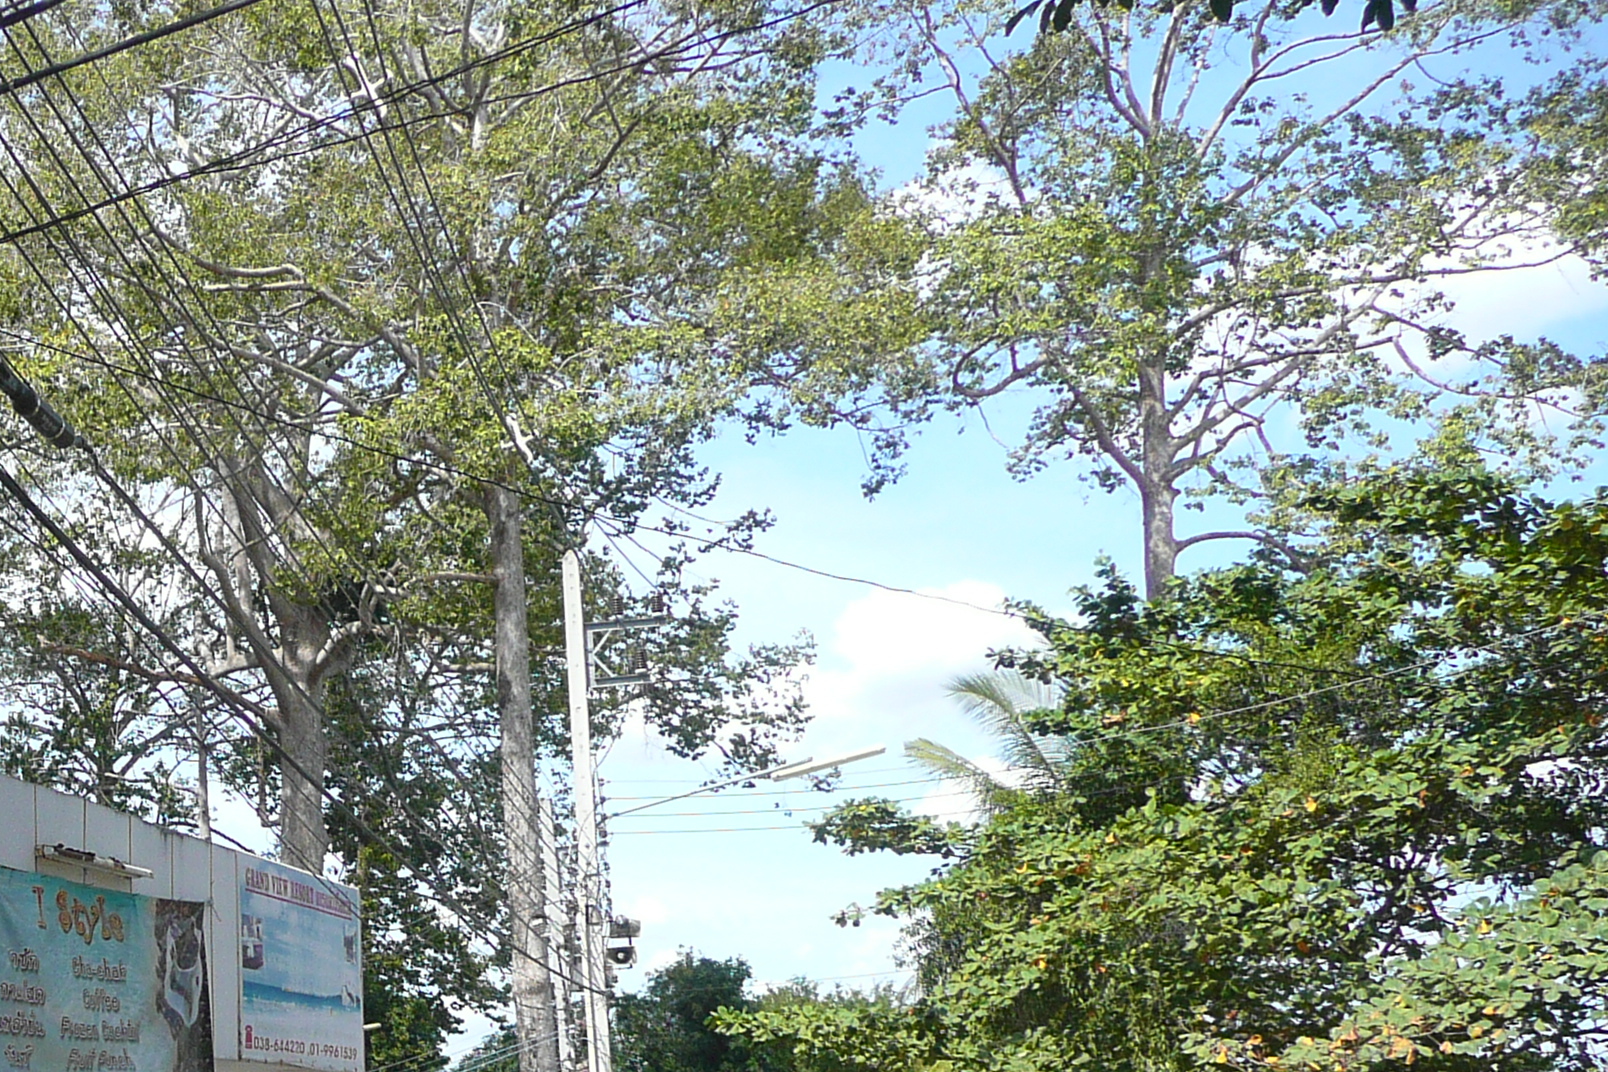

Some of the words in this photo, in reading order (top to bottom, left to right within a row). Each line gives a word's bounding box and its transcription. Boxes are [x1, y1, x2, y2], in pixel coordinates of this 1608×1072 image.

[32, 886, 47, 929] I
[56, 890, 124, 945] Style
[82, 987, 120, 1013] Coffee
[253, 1036, 305, 1055] 038-644220
